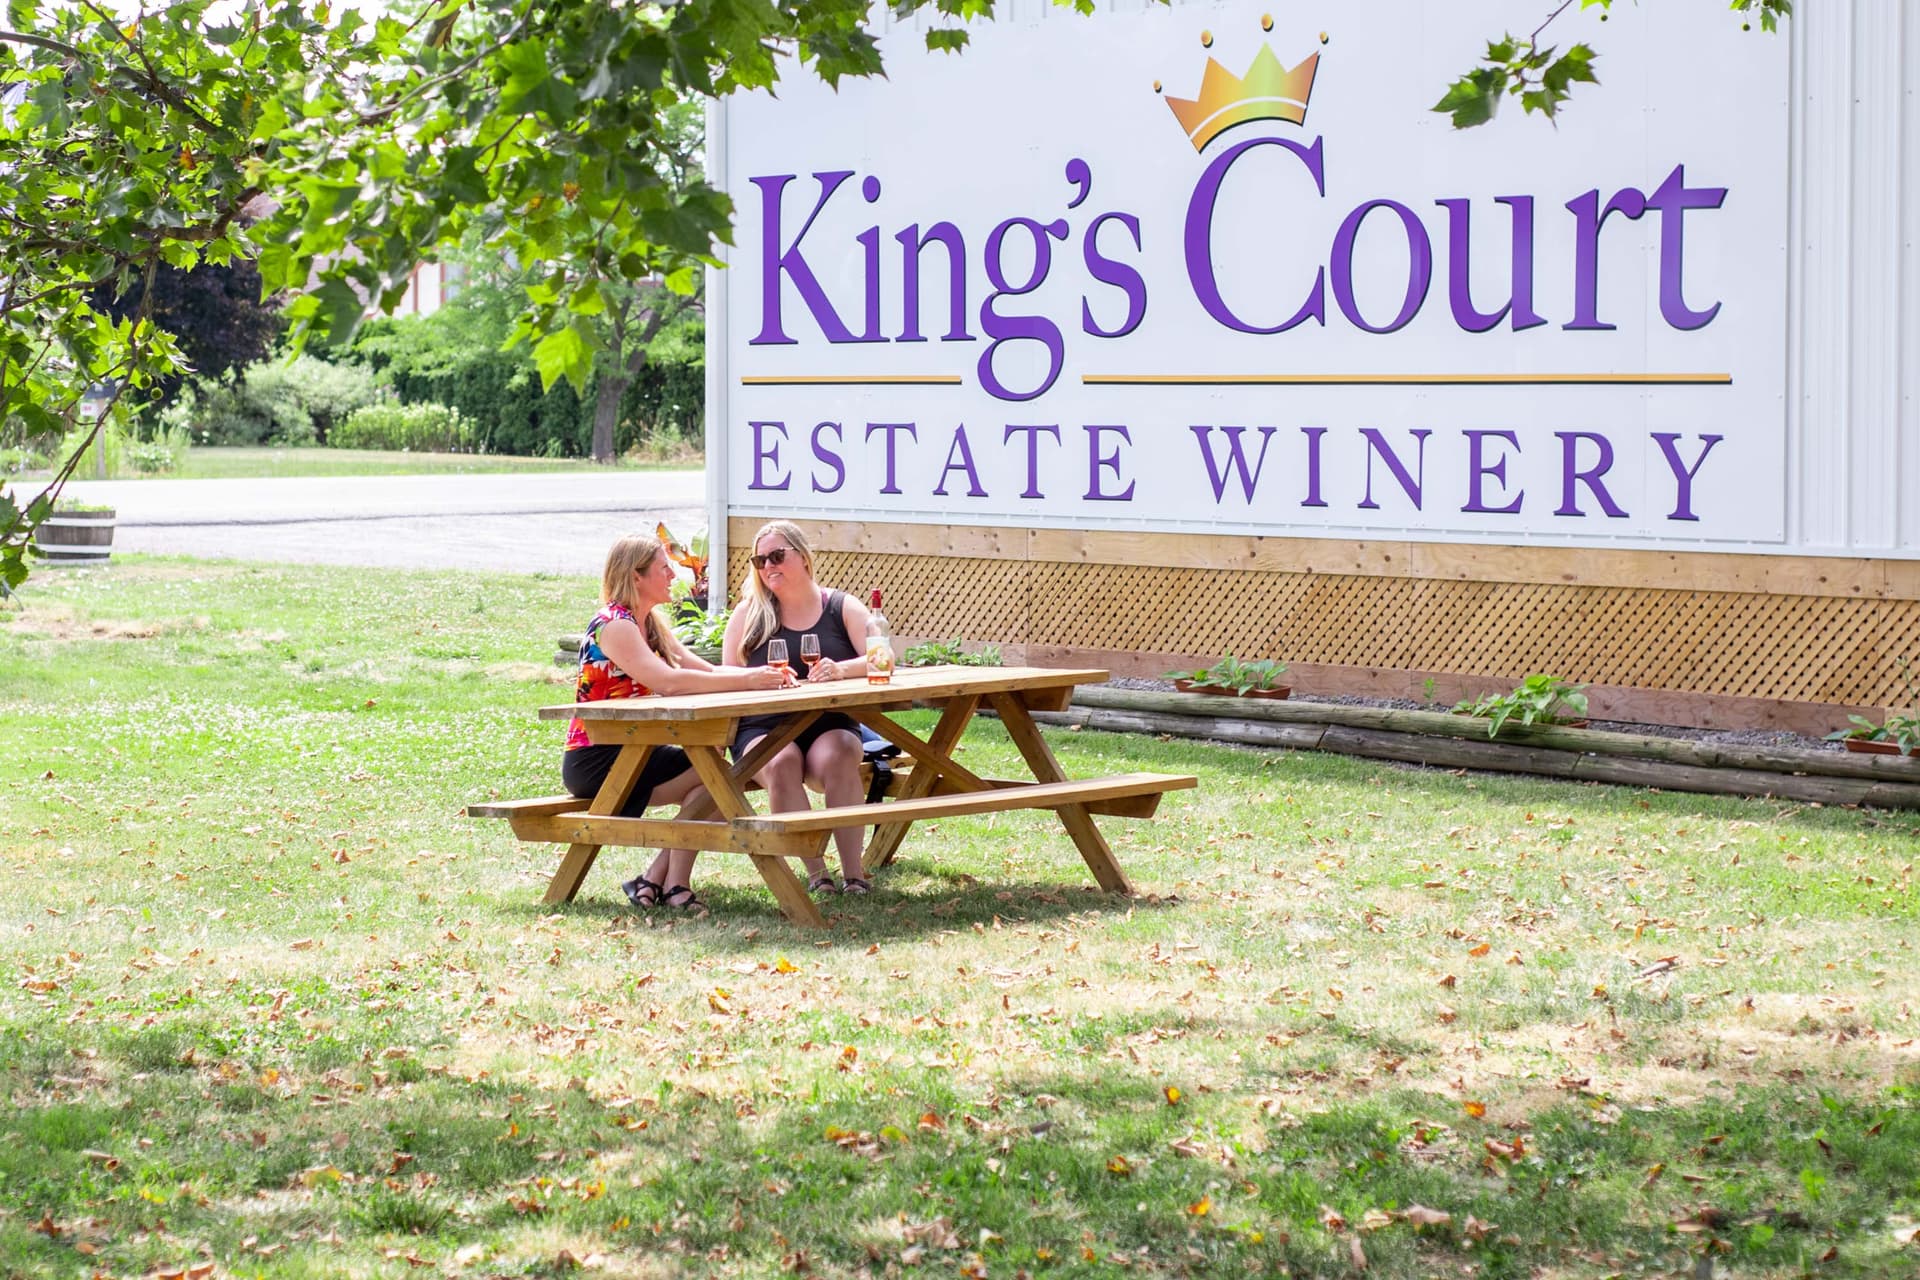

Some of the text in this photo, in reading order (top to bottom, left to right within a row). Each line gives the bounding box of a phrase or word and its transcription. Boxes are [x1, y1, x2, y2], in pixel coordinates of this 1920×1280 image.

[748, 134, 1729, 402] King's Court
[748, 421, 1724, 522] ESTATE WINERY
